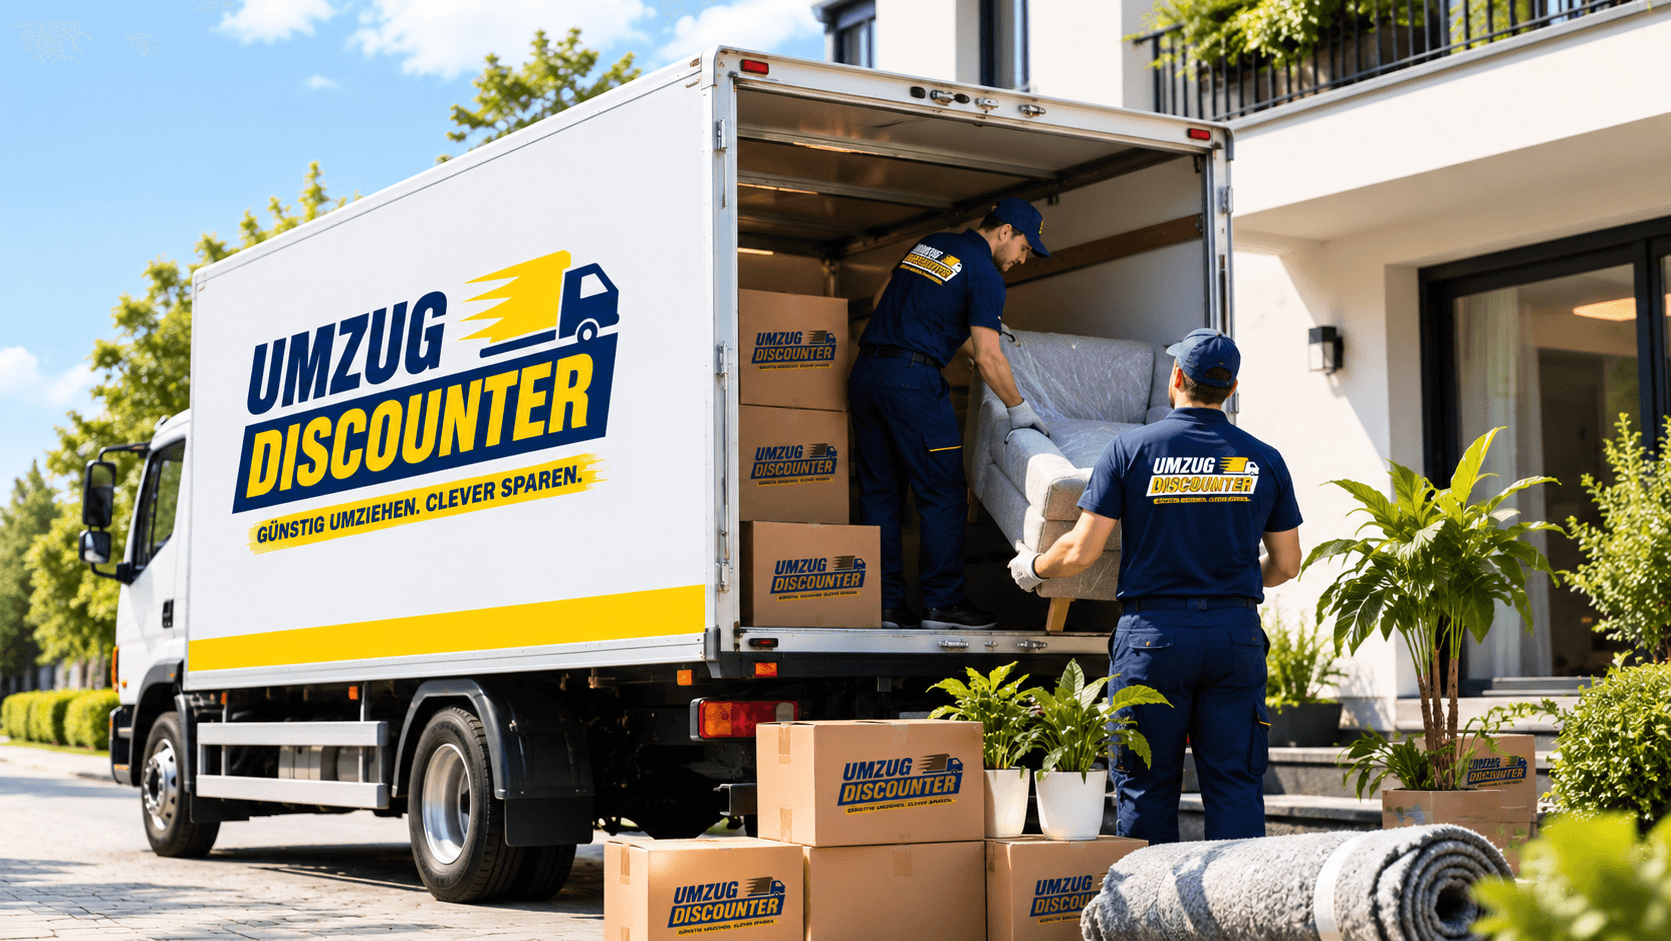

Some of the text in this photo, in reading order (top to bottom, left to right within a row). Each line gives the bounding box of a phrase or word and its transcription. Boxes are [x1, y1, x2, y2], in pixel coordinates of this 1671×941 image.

[756, 331, 803, 346] UMZUG
[247, 290, 448, 415] UMZUG
[755, 347, 832, 361] DISCOUNTER
[246, 353, 593, 499] DISCOUNTER
[755, 445, 804, 461] UMZUG
[754, 460, 833, 477] DISCOUNTER
[1152, 457, 1216, 474] UMZUG
[1150, 476, 1253, 494] DISCOUNTER
[256, 465, 583, 545] GÜNSTIG UMZIEHEN. CLEVER SPAREN.
[775, 557, 828, 575] UMZUG
[774, 572, 861, 591] DISCOUNTER
[843, 757, 913, 781] UMZUG
[842, 775, 957, 803] DISCOUNTER
[673, 881, 739, 904] UMZUG
[1034, 875, 1093, 896] UMZUG
[672, 897, 779, 925] DISCOUNTER
[1034, 893, 1095, 914] DISCOU
